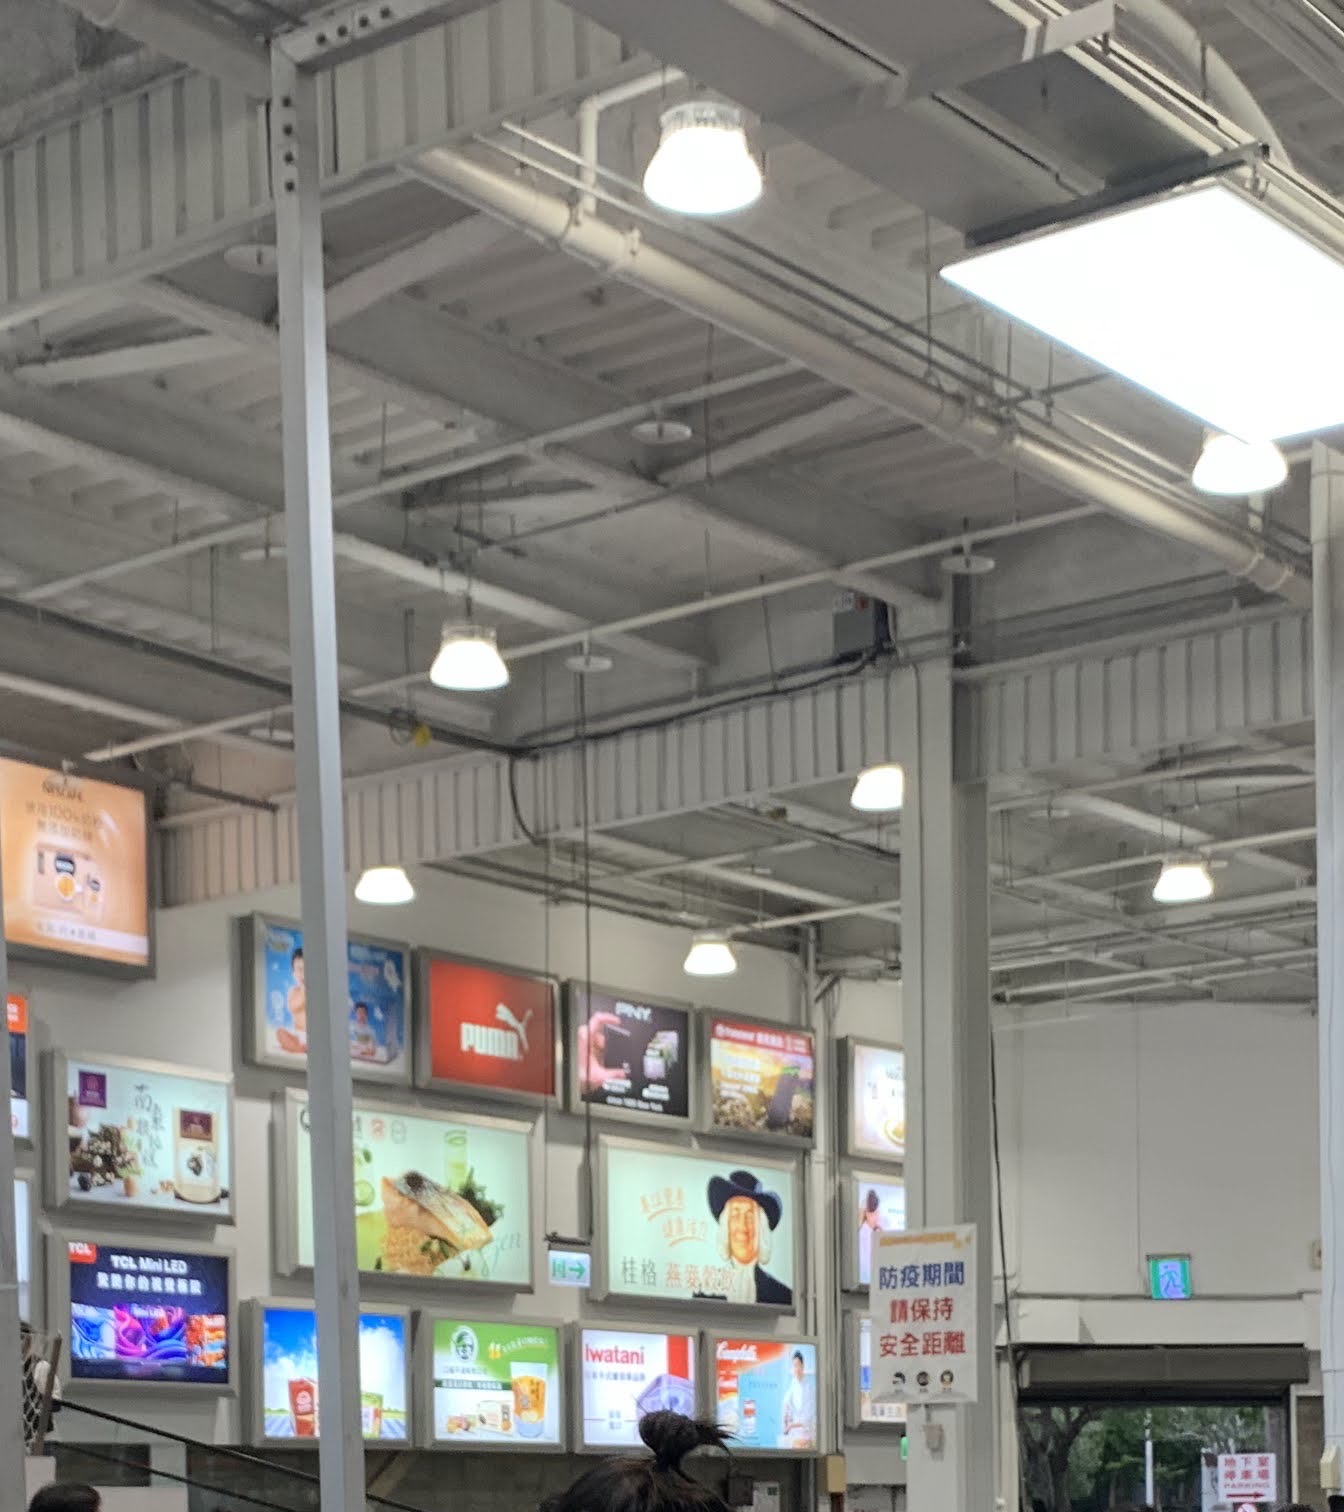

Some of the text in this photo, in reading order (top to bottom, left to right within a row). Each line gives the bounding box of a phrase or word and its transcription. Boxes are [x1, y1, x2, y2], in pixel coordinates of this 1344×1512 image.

[110, 1254, 138, 1270] TCL
[164, 1259, 188, 1275] LED
[622, 1255, 657, 1286] 桂格
[879, 1260, 966, 1291] 防疫期間
[889, 1297, 954, 1324] 請保持
[584, 1343, 645, 1365] Iwatani
[879, 1331, 967, 1358] 安全距離
